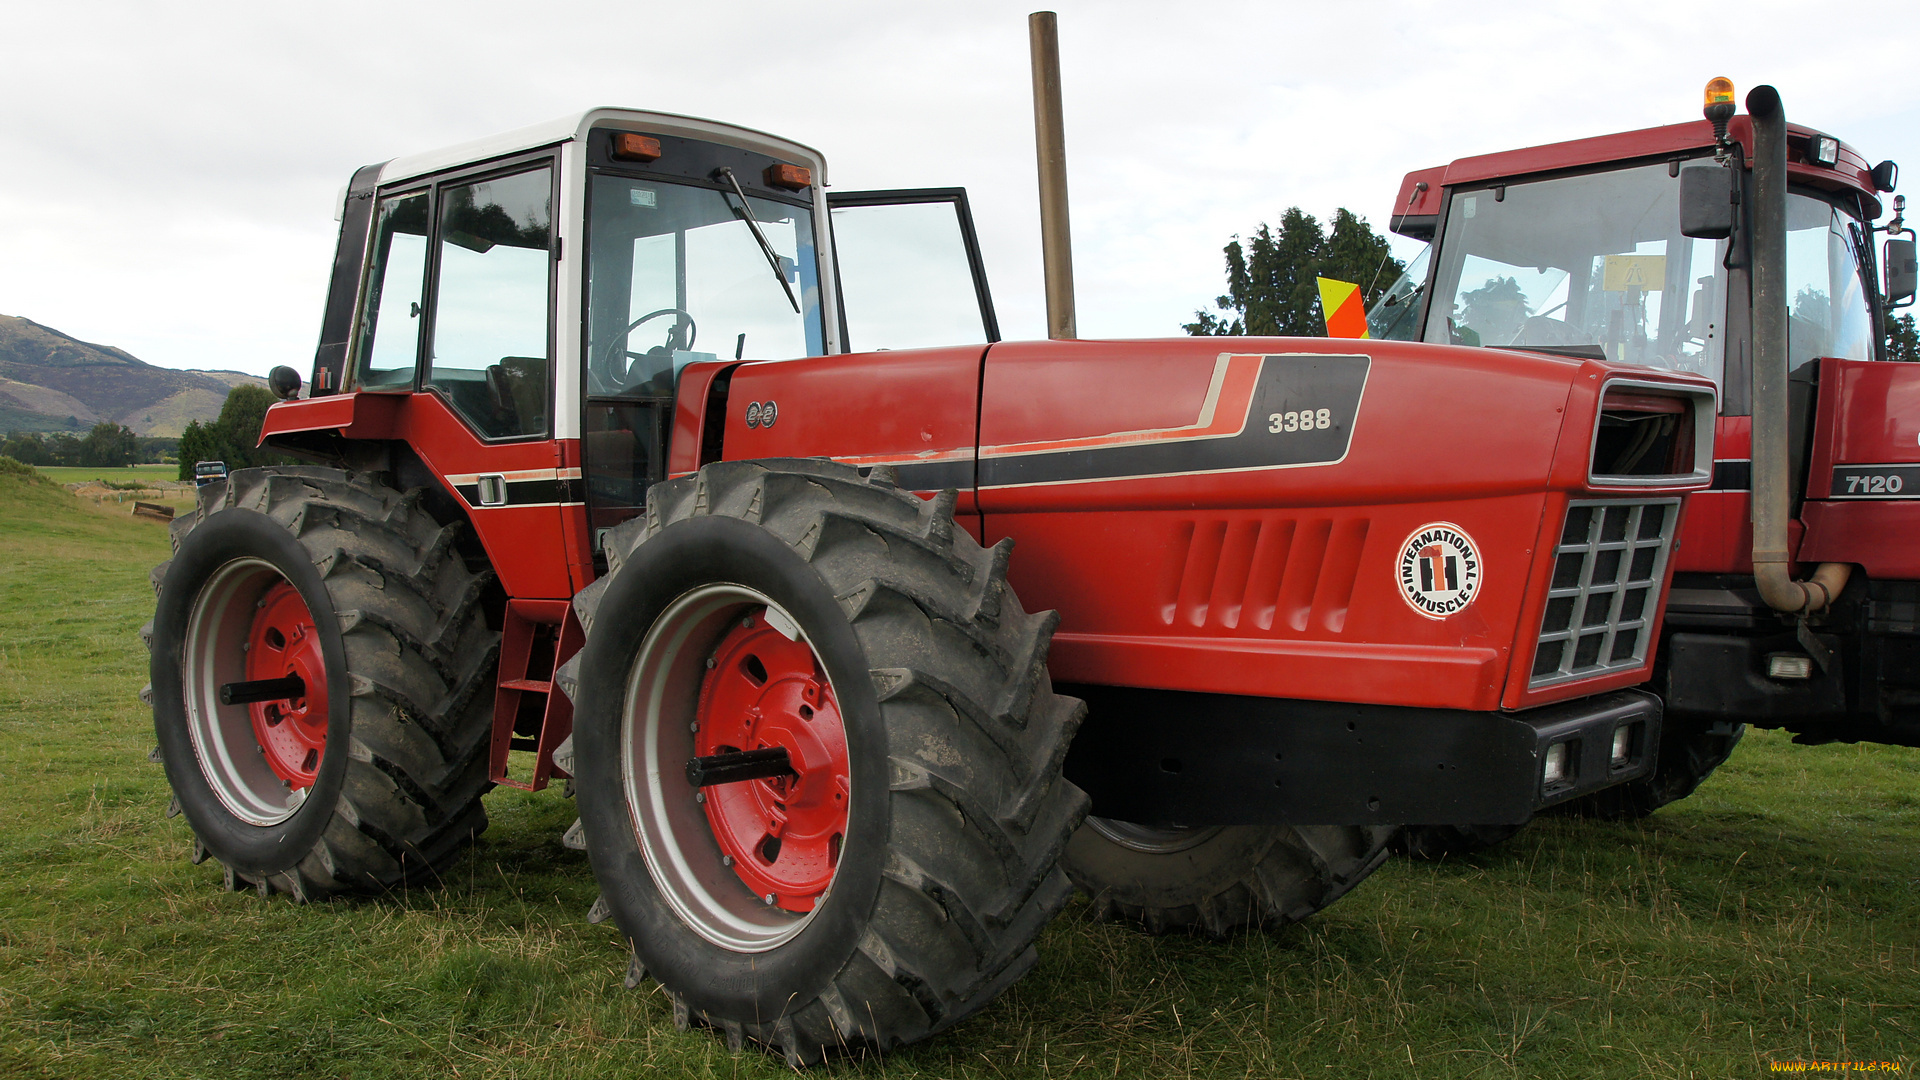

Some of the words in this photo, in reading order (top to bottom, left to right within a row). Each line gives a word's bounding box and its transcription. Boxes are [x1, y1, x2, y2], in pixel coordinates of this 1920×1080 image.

[1268, 408, 1331, 434] 3388
[1845, 475, 1903, 493] 7120
[1402, 530, 1476, 584] INTERNATIONAL
[1411, 589, 1470, 613] MUSCLE
